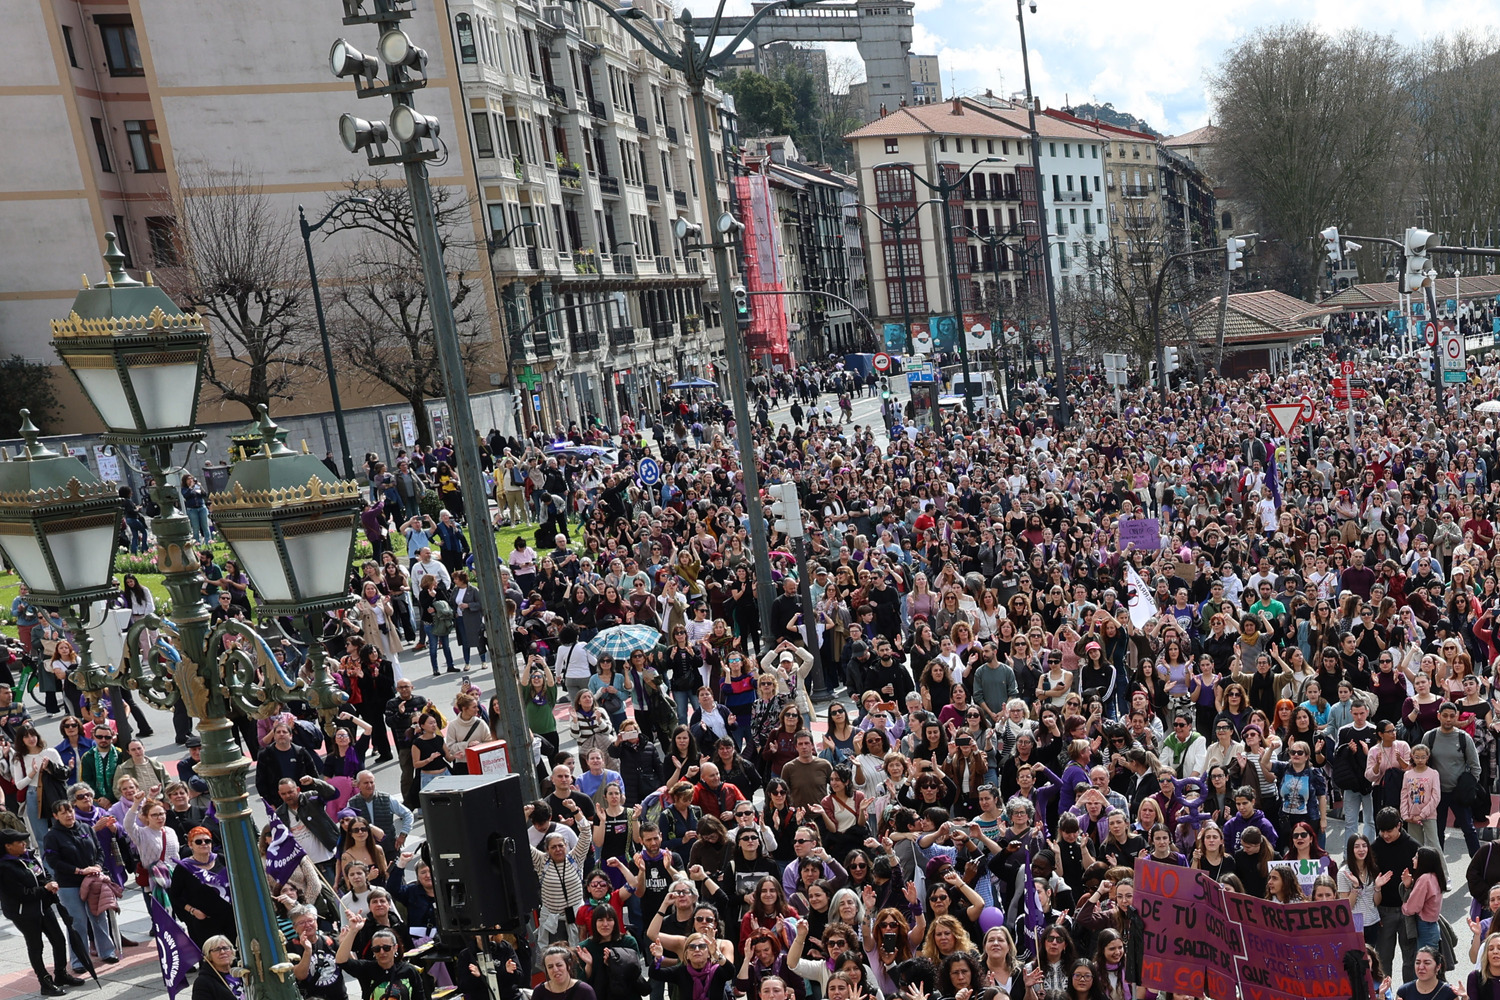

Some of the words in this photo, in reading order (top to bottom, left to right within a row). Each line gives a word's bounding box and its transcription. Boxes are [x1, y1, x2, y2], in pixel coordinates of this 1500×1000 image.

[1141, 864, 1179, 898] NO
[1230, 898, 1257, 924] TE
[1262, 904, 1350, 932] PREFIERO
[1141, 898, 1162, 921] DE
[1172, 902, 1197, 929] TÚ
[1144, 928, 1167, 954] TÚ
[1174, 937, 1218, 965] SALISTE
[1142, 961, 1163, 983] MI
[1242, 965, 1272, 989] QUE
[1275, 975, 1353, 999] VIOLADA
